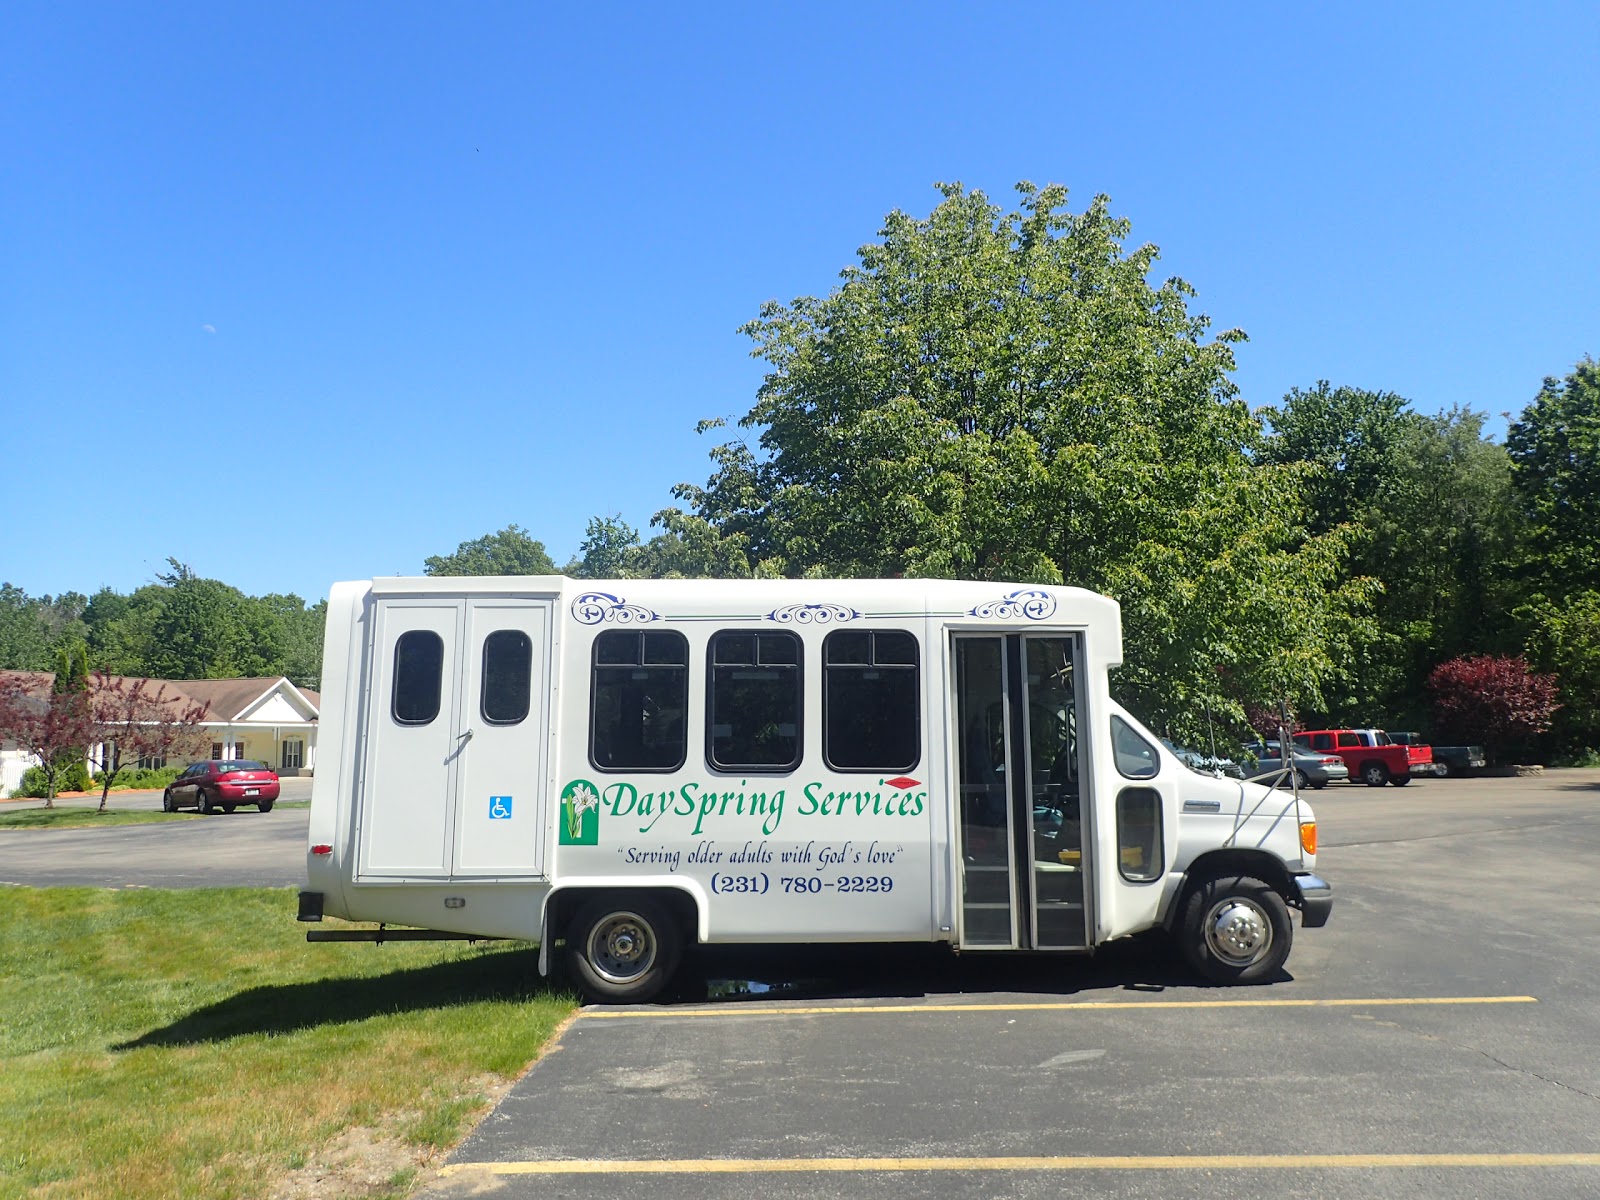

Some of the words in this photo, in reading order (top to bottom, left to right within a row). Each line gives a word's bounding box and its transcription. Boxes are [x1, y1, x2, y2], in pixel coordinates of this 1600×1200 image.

[602, 779, 786, 836] DaySpring
[797, 779, 928, 817] Services
[687, 840, 723, 864] older
[729, 840, 774, 864] adults
[780, 840, 815, 864] with
[816, 840, 862, 872] God's
[710, 872, 770, 895] (231)
[780, 876, 894, 894] 780-2229
